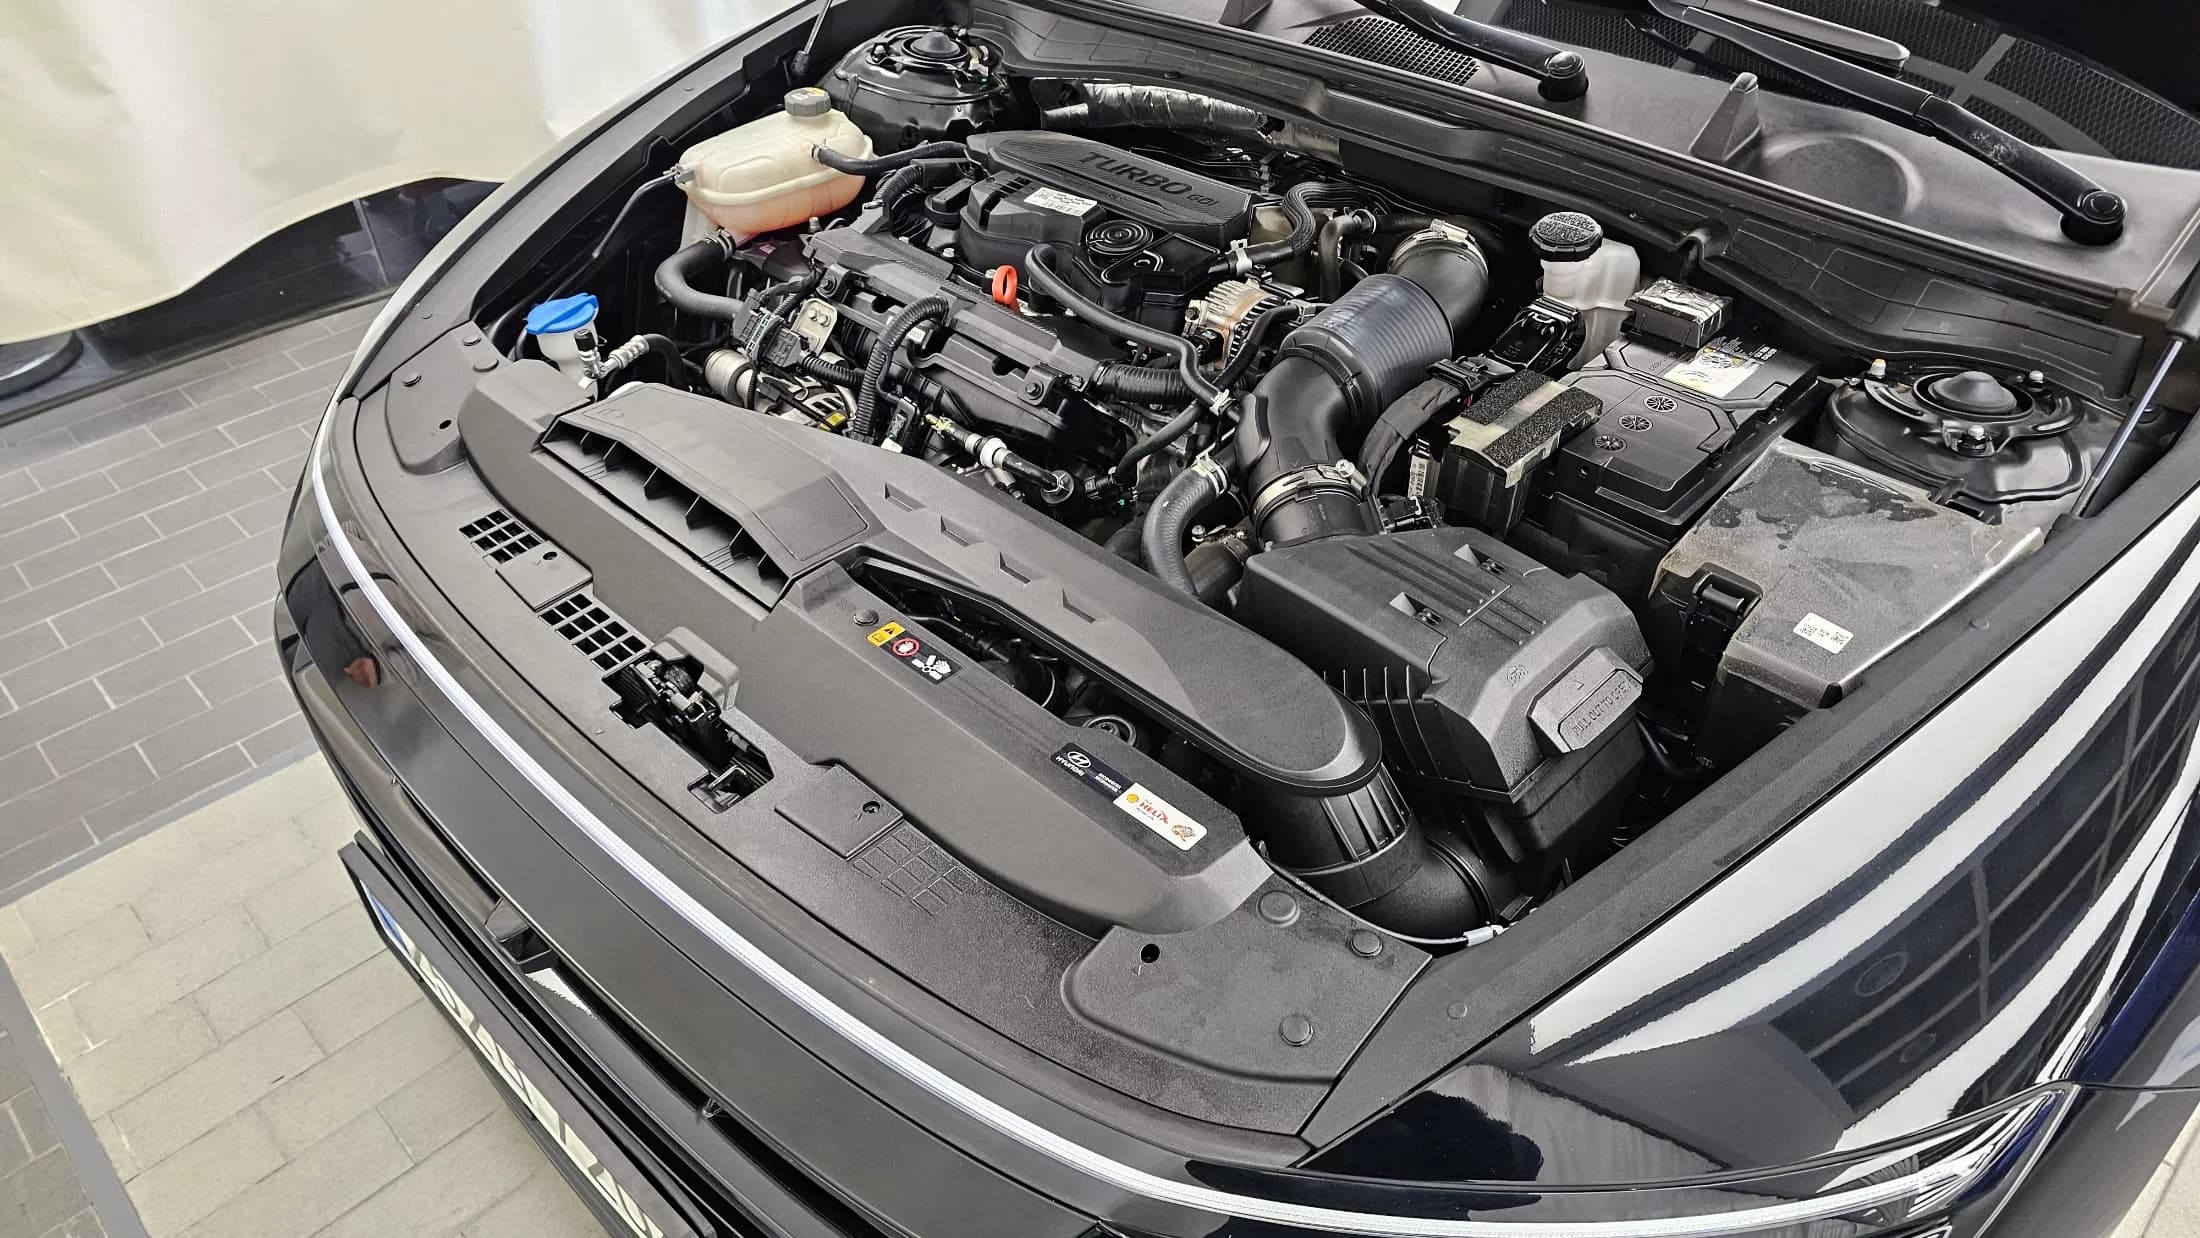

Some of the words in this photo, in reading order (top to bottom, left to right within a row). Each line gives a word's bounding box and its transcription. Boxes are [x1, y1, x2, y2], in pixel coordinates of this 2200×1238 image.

[1079, 152, 1192, 194] TURBO
[1572, 718, 1592, 736] PULL
[1589, 704, 1604, 720] OUT
[1601, 697, 1613, 709] TO
[1055, 755, 1086, 777] HYUNDAI
[1139, 802, 1168, 824] HELIX
